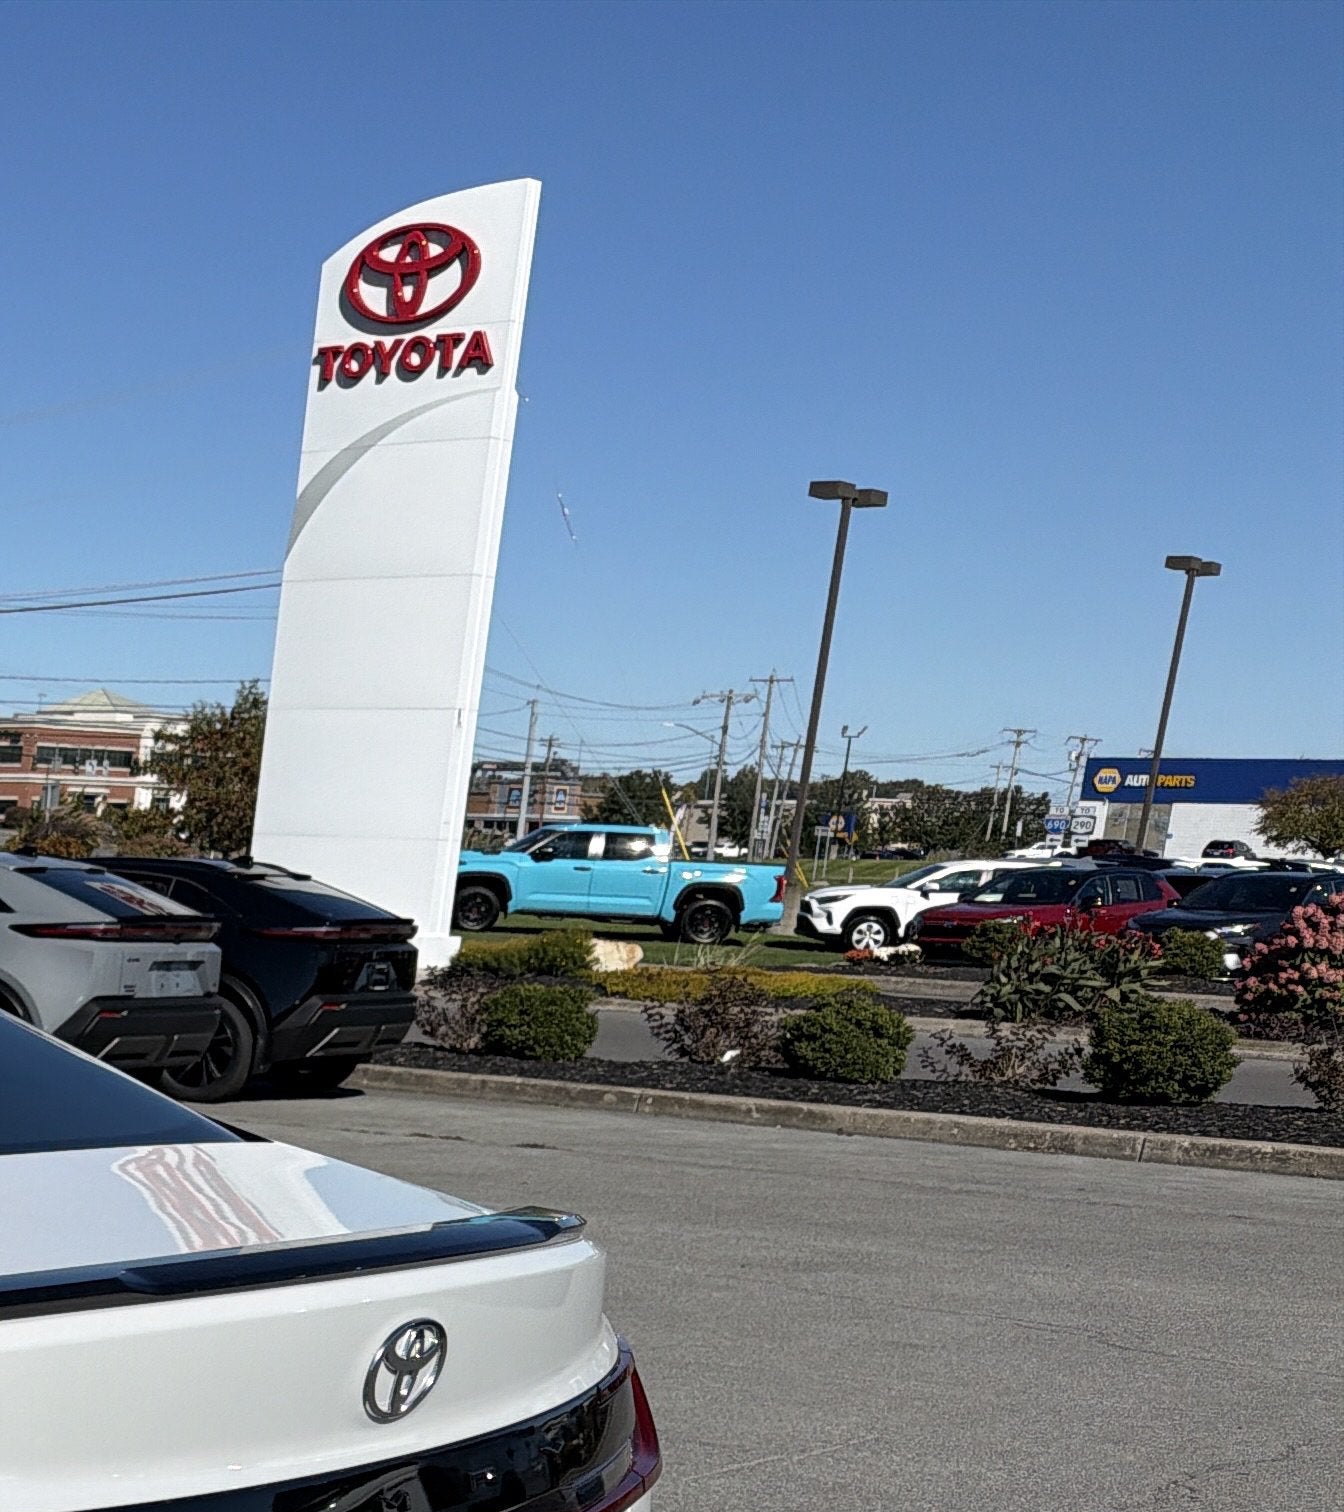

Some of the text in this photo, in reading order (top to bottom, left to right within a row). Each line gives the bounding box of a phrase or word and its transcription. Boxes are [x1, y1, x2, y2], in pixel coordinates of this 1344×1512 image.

[316, 330, 494, 384] TOYOTA
[1124, 774, 1152, 787] AUT
[1156, 775, 1195, 787] PARTS
[1047, 820, 1067, 830] 690
[1073, 820, 1092, 830] 290
